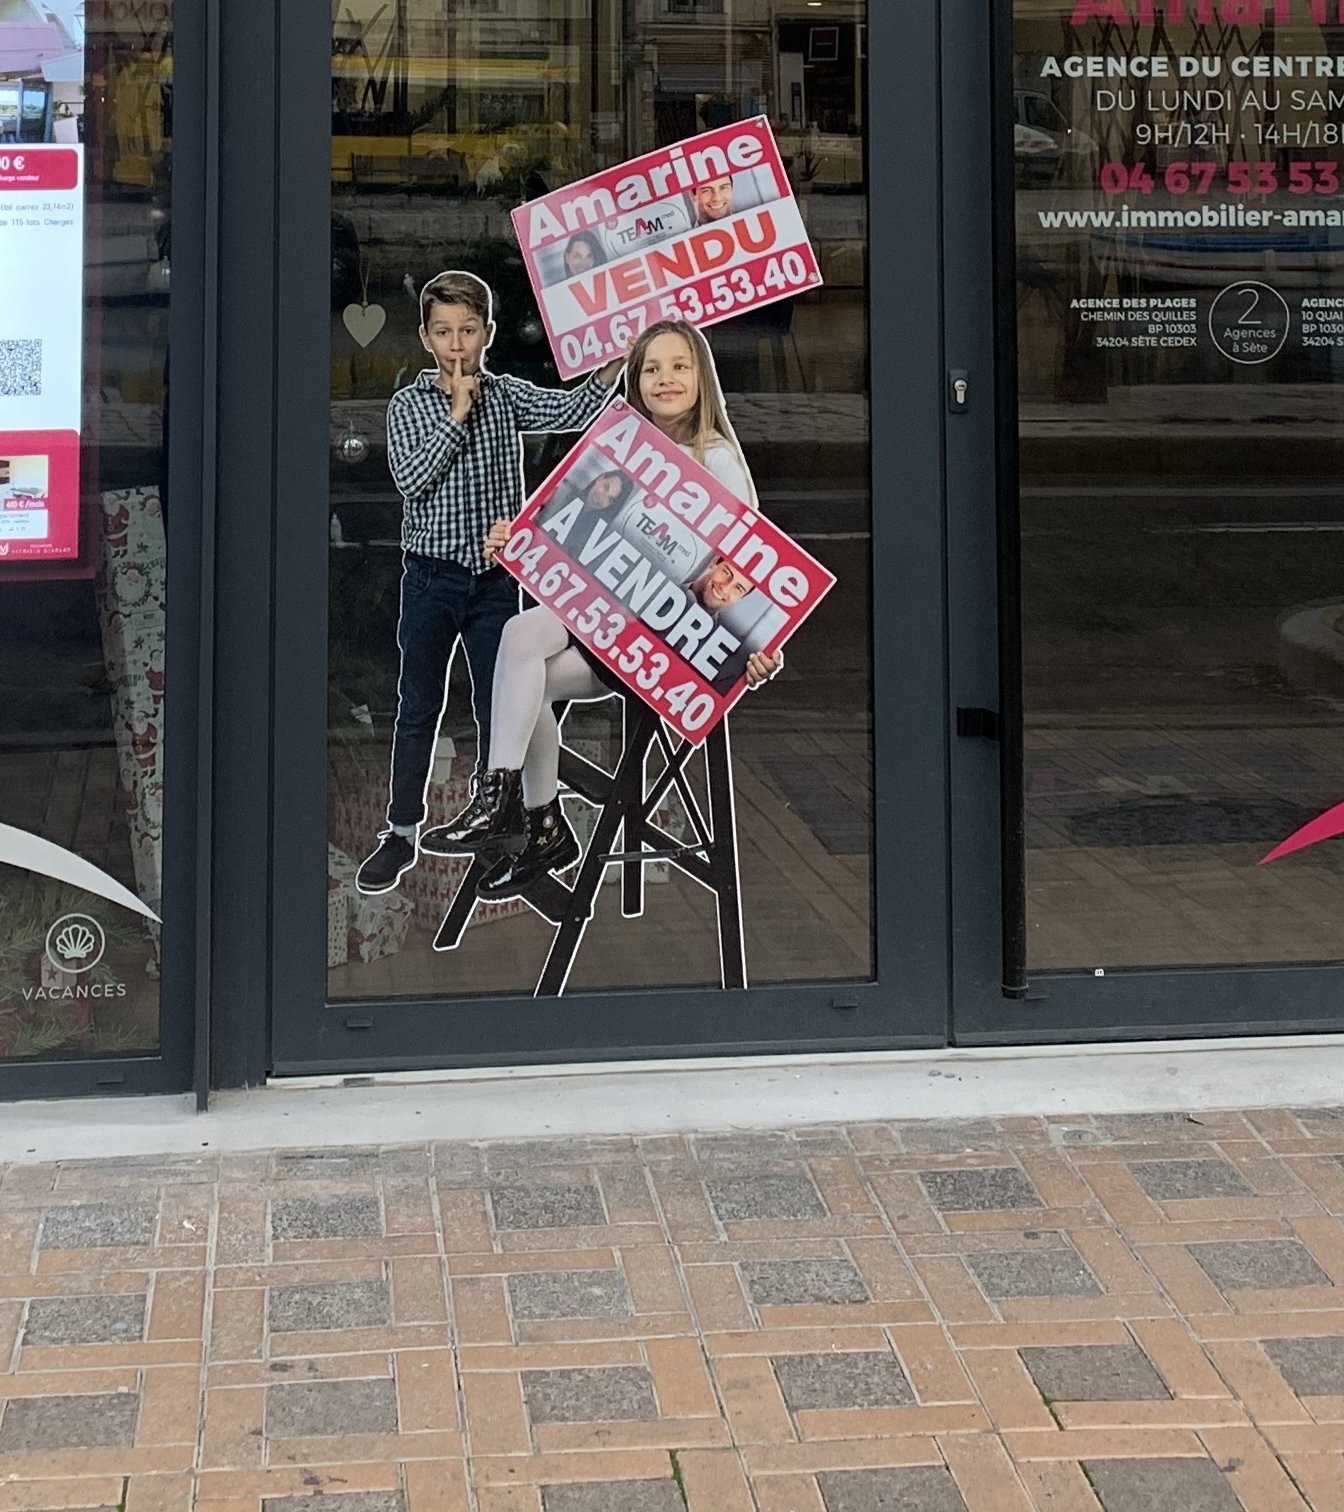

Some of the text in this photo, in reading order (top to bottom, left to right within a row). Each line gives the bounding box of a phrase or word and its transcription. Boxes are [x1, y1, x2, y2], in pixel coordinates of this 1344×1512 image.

[1040, 55, 1169, 79] AGENCE
[1179, 55, 1221, 78] DU
[1096, 89, 1136, 112] DU
[1147, 89, 1231, 112] LUNDI
[1241, 89, 1281, 112] AU
[1135, 122, 1230, 147] 9H/12H
[13, 155, 25, 170] €
[1100, 161, 1155, 195] 04
[1164, 161, 1217, 195] 67
[1226, 161, 1278, 195] 53
[1288, 161, 1339, 195] 53
[529, 134, 764, 249] Amarine
[616, 215, 664, 246] TEAM
[568, 210, 778, 317] VENDU
[560, 250, 807, 369] 04.6753.53.40
[1070, 298, 1197, 308] AGENCE DES PLAGES
[1237, 288, 1262, 324] 2
[1080, 311, 1197, 321] CHEMIN DES QUILLES
[1301, 311, 1313, 321] 10
[1315, 311, 1343, 321] QUAI
[1148, 324, 1197, 334] BP 10303
[1223, 328, 1276, 339] Agences
[1302, 324, 1318, 334] BP
[1096, 337, 1129, 347] 34204
[1159, 337, 1197, 347] CEDEX
[1232, 342, 1268, 353] à Sète
[1302, 337, 1335, 347] 34204
[594, 413, 810, 607] Amarine
[632, 511, 681, 558] TEAM
[543, 497, 742, 682] A VENDRE
[506, 527, 716, 733] 04.67.53.53.40
[22, 982, 127, 1001] VACANCES
